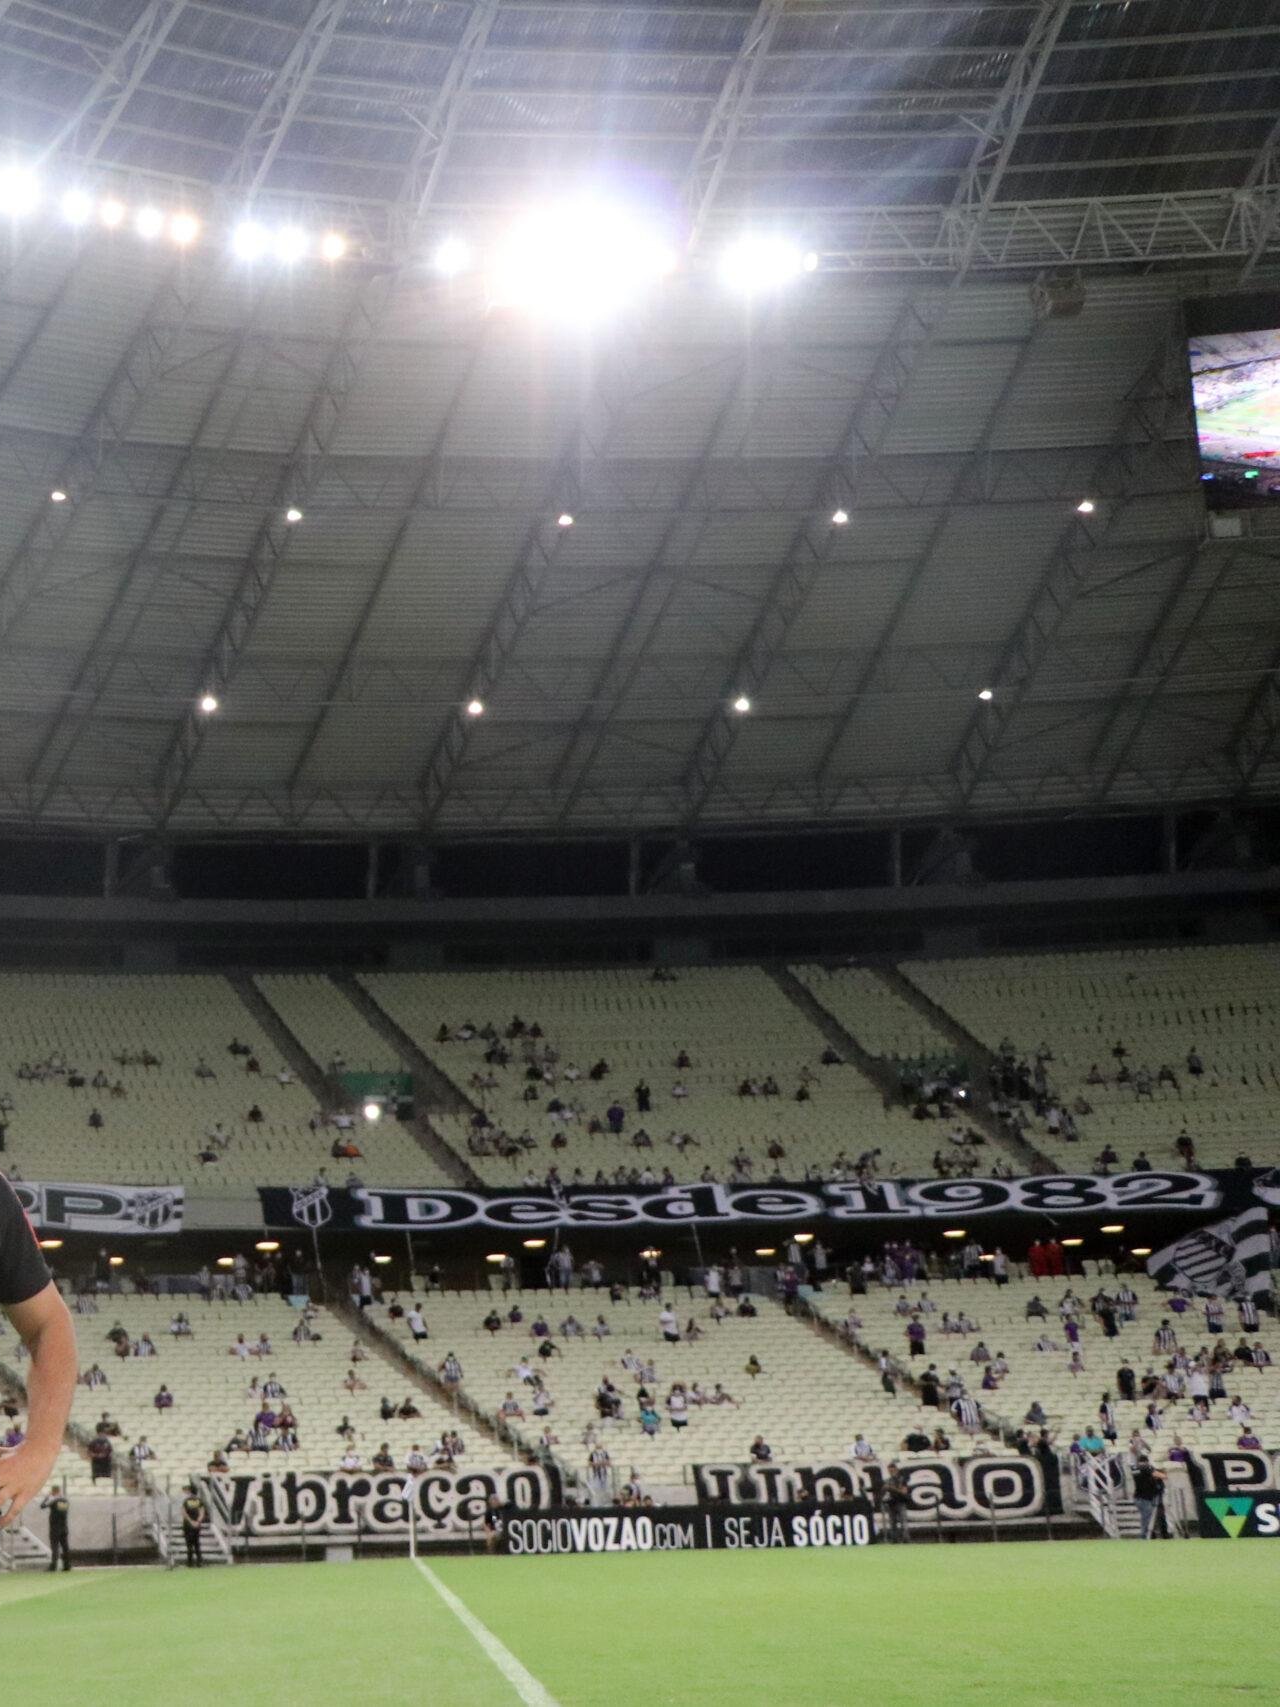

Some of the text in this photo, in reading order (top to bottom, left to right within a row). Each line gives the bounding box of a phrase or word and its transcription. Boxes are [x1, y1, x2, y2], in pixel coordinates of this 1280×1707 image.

[361, 1183, 815, 1228] Desde
[829, 1172, 1218, 1217] 1982
[1200, 1450, 1276, 1492] P
[724, 1516, 786, 1549] SEJA
[792, 1510, 870, 1548] SÓCIO
[1255, 1502, 1280, 1533] S
